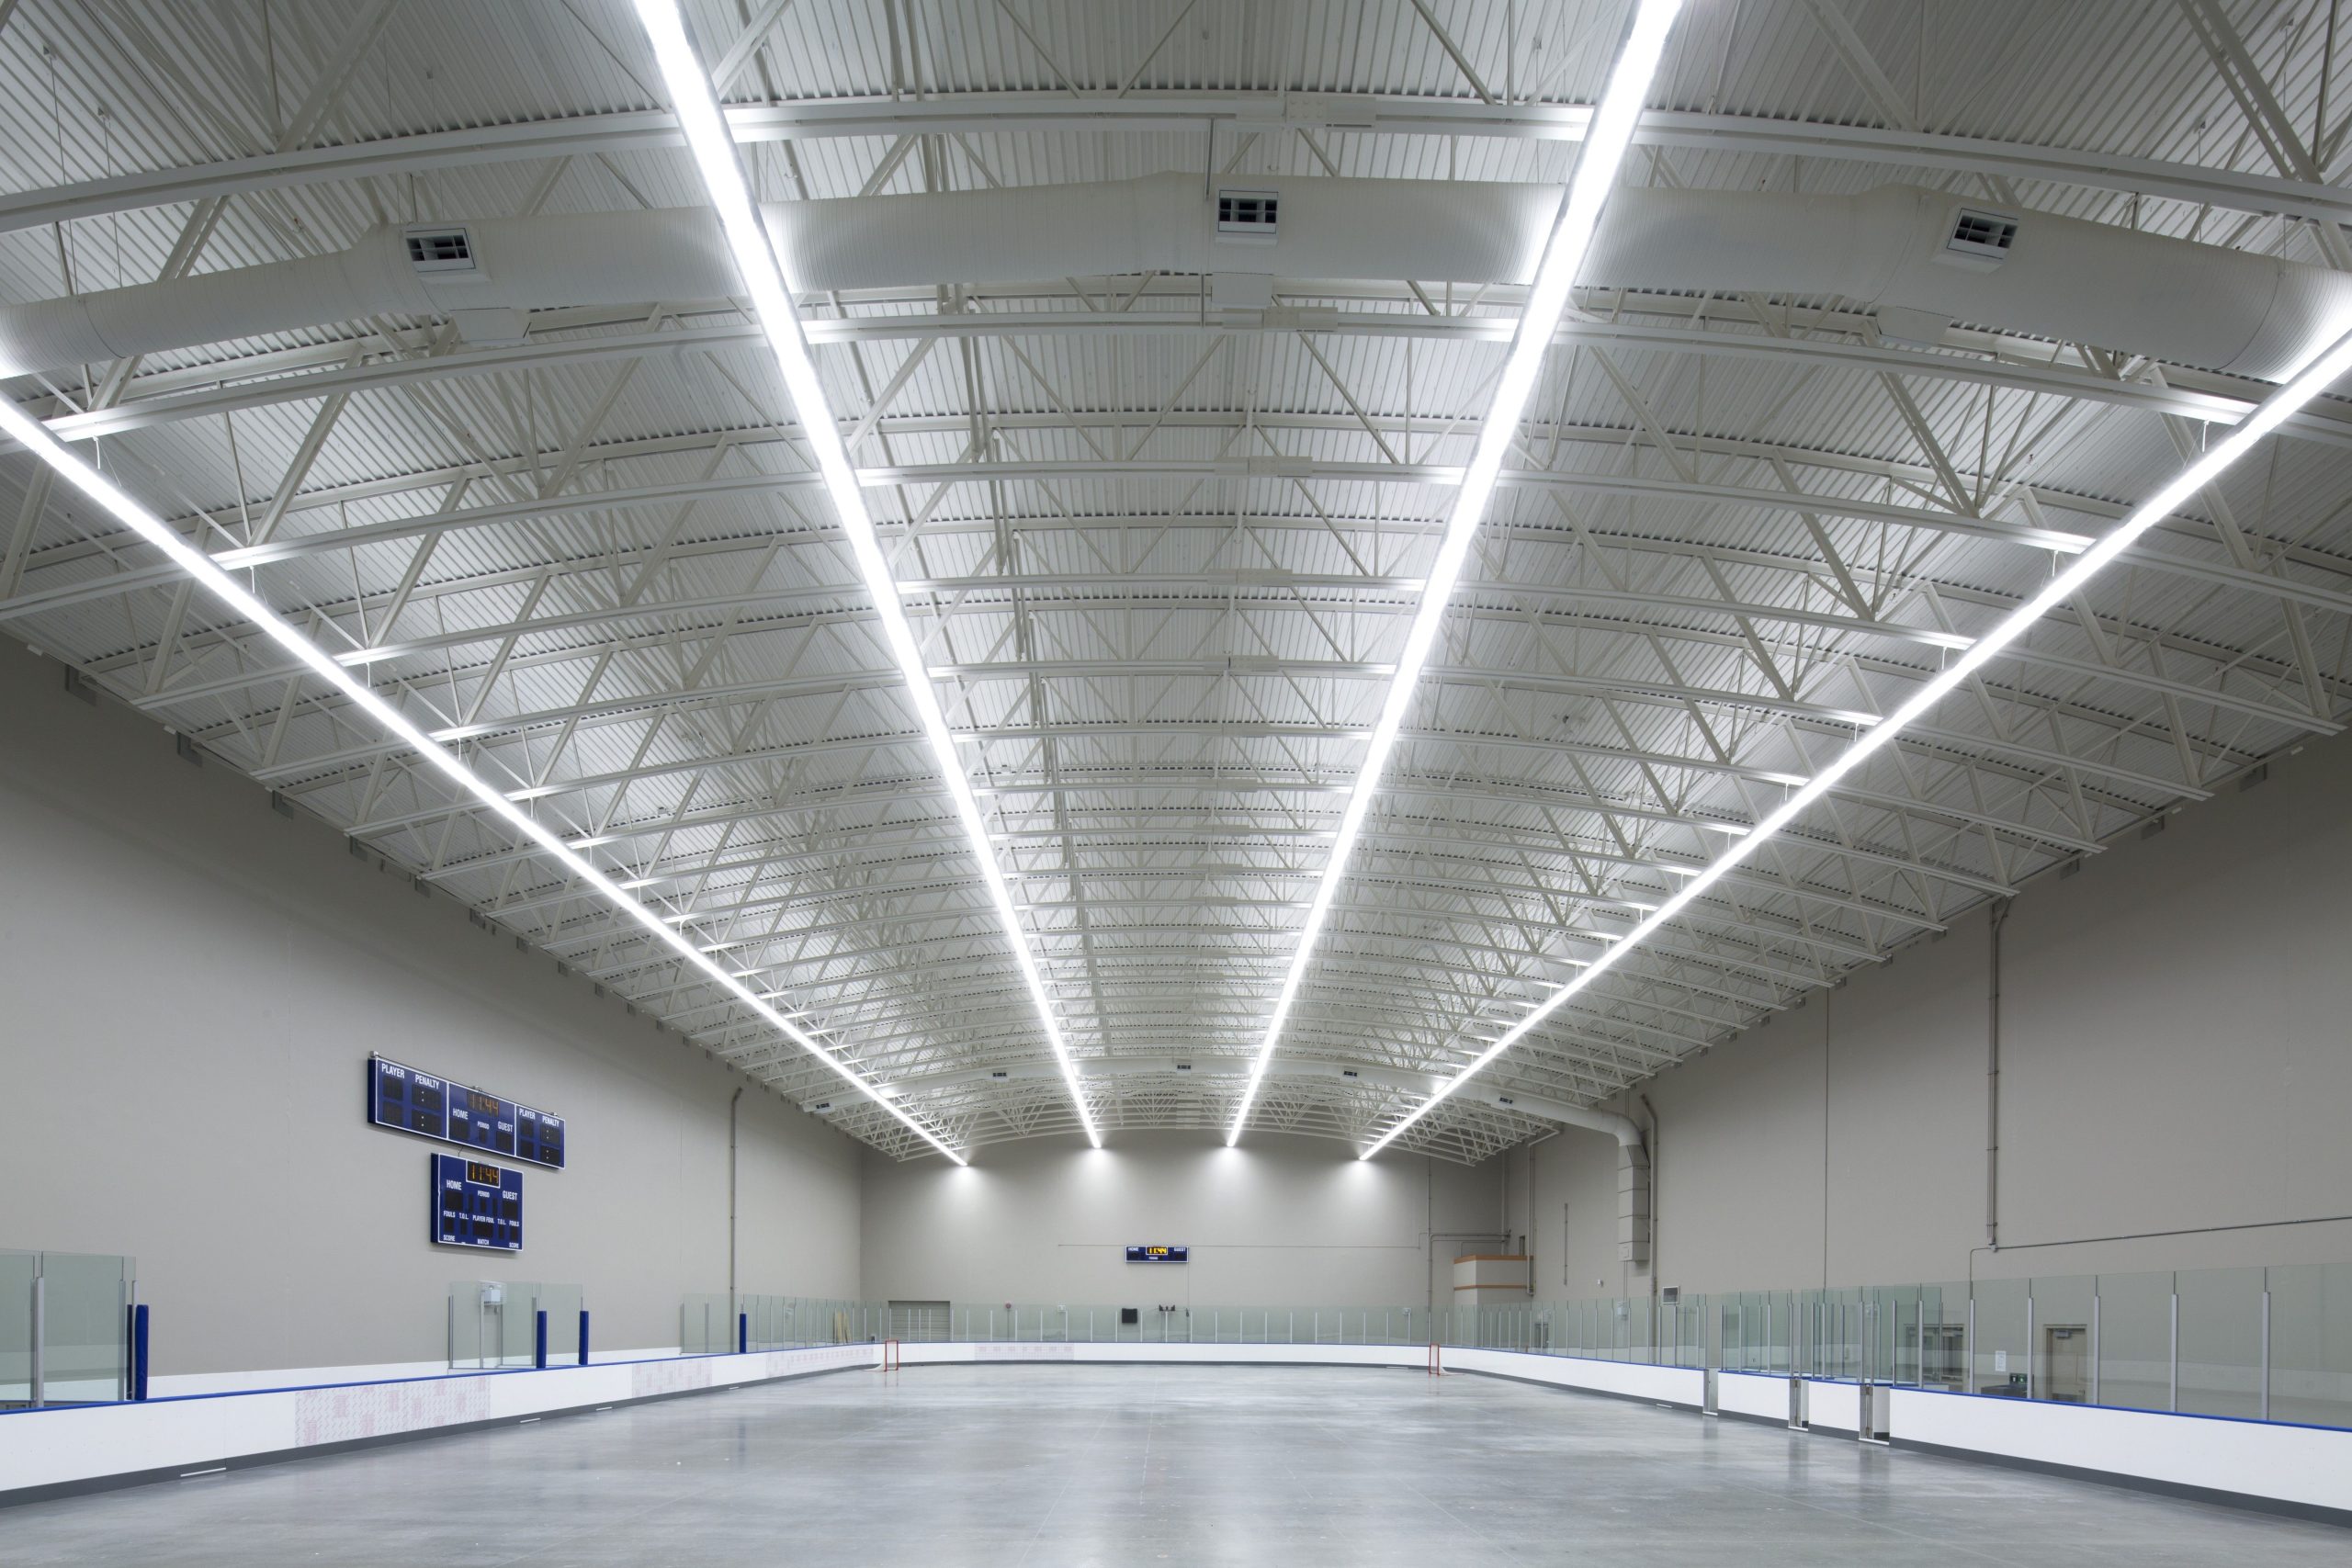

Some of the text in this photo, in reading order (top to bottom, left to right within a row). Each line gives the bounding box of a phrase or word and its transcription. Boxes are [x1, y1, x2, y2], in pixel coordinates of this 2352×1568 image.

[381, 1063, 439, 1090] PLAYER PENALTY
[453, 1108, 469, 1120] HOME
[519, 1108, 560, 1127] PLAYER PENALTY
[497, 1121, 514, 1133] GUEST
[447, 1179, 462, 1190] HOME
[503, 1190, 517, 1201] GUEST
